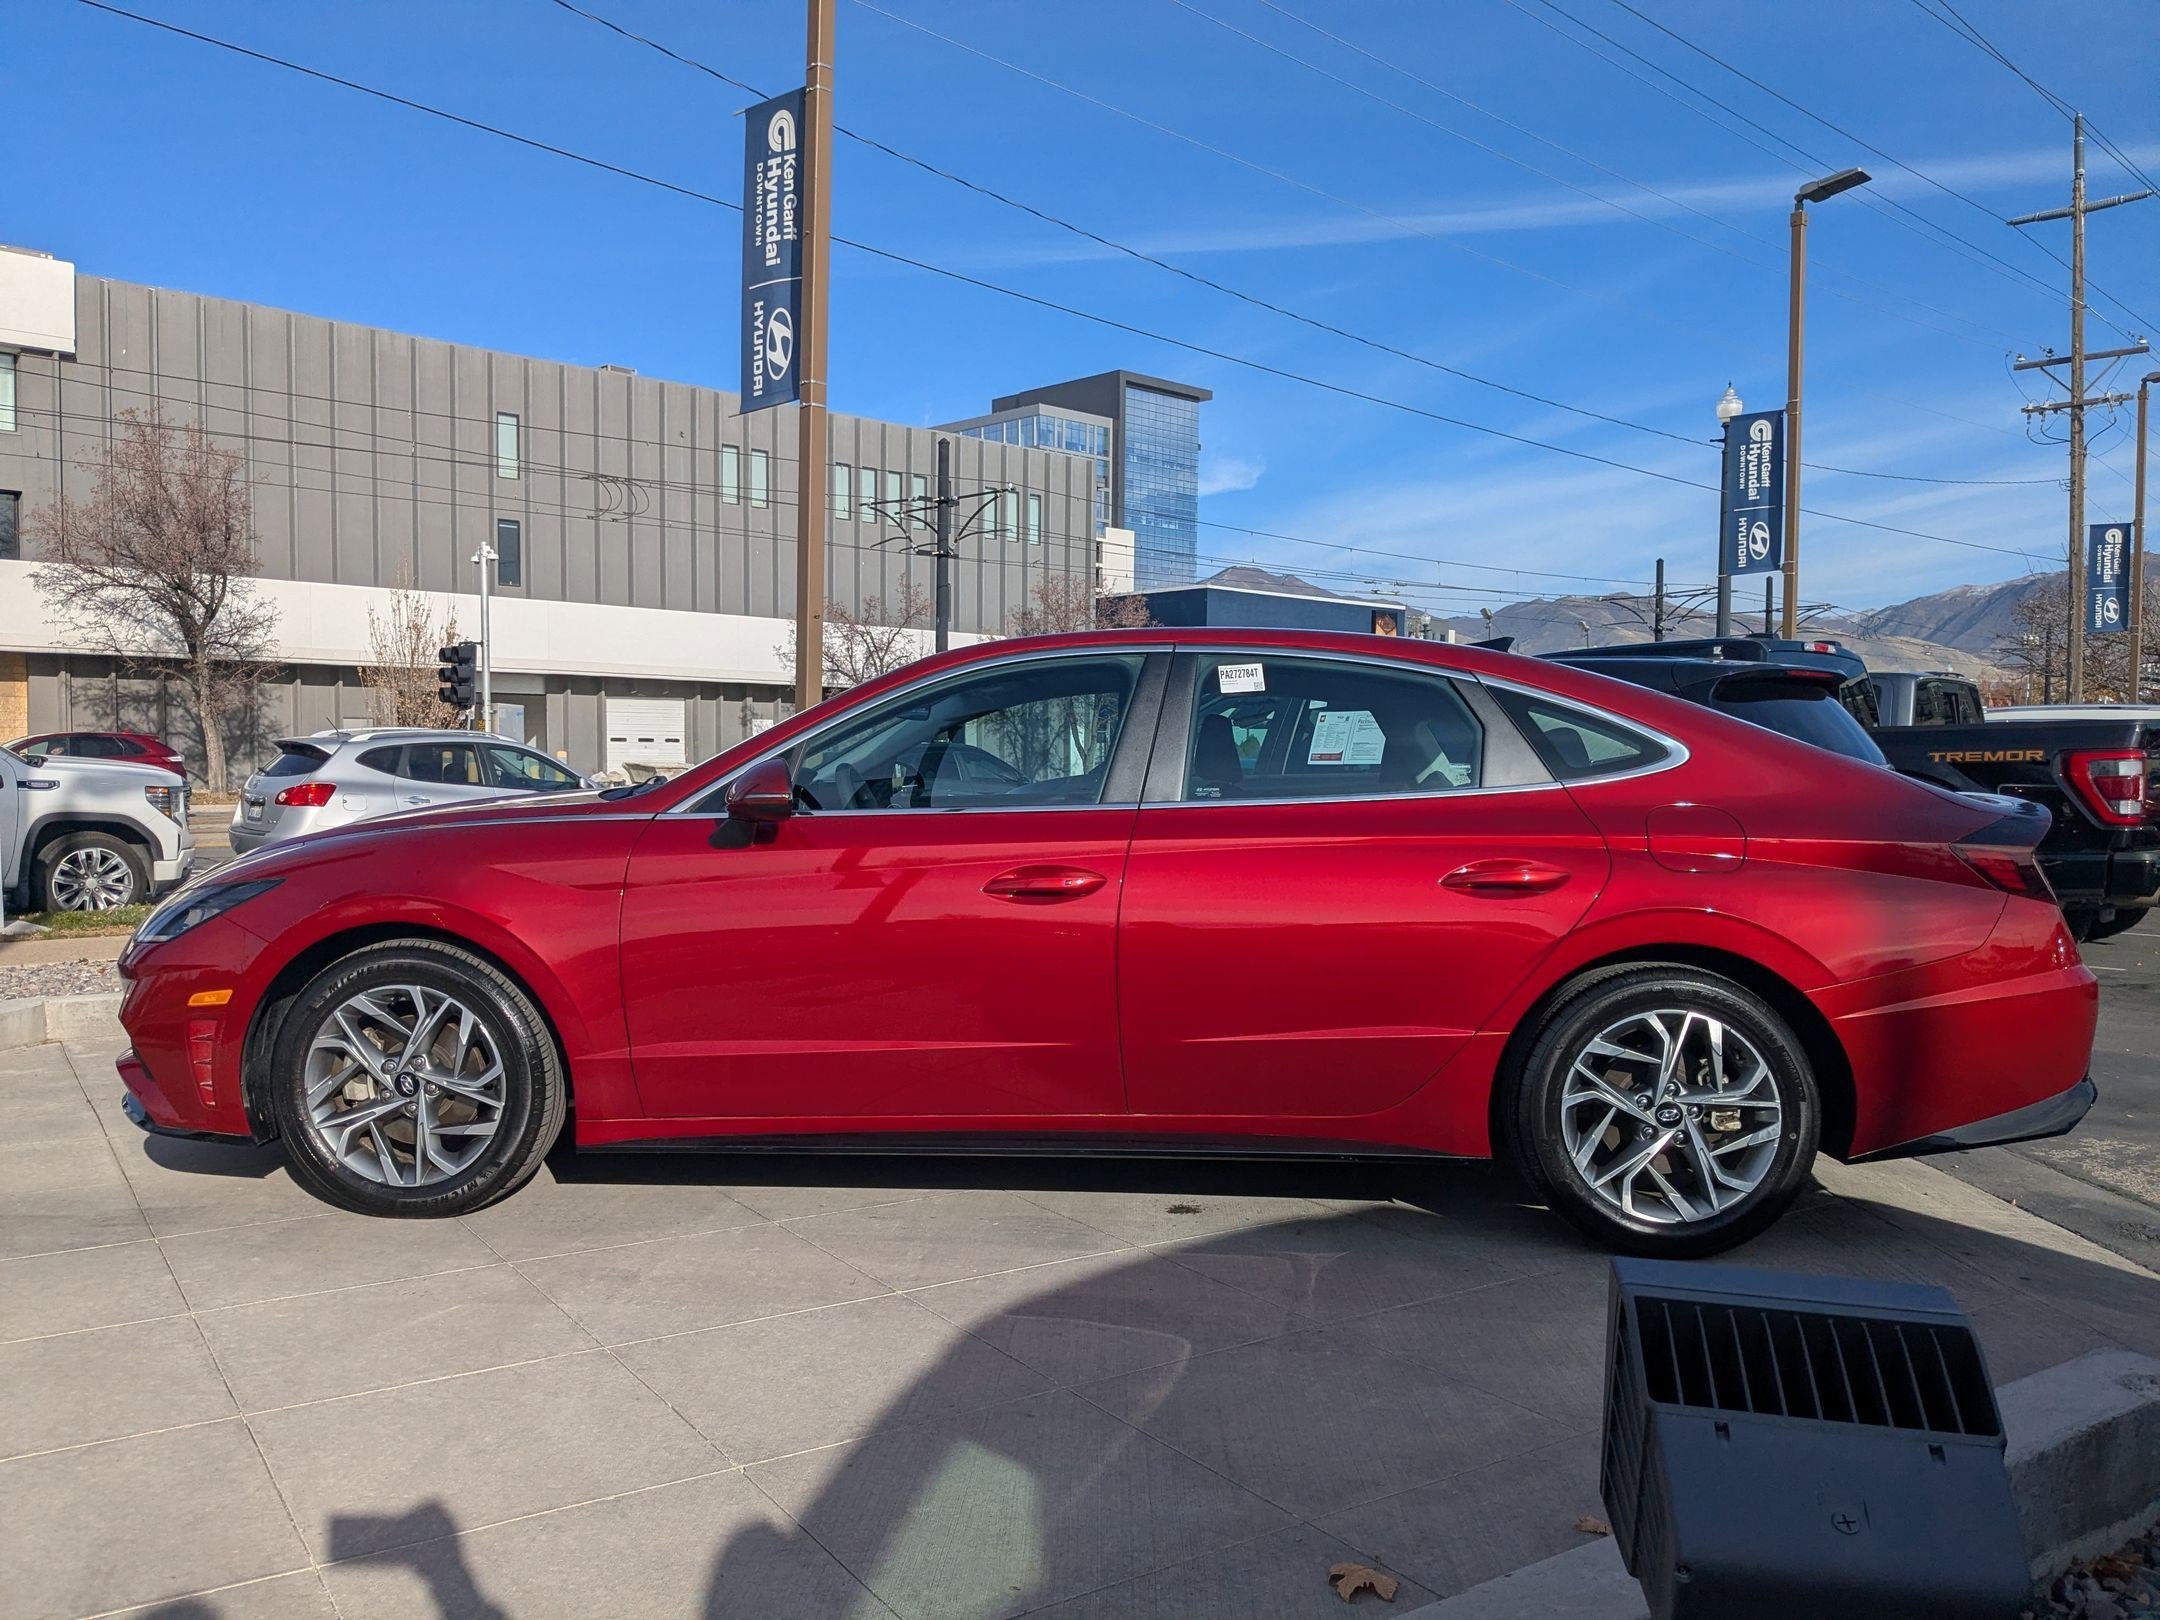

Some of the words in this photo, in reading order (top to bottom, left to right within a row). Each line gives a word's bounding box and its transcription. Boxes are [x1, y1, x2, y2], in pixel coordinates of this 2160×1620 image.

[784, 153, 797, 192] Ken
[755, 162, 763, 247] DOWNTOWN
[765, 156, 781, 267] Hyundai
[783, 193, 797, 240] Garff
[753, 300, 764, 397] HYUNDAI
[1747, 443, 1760, 500] Hyundai
[1762, 442, 1772, 462] Ken
[1738, 517, 1747, 568] HYUNDAI
[2103, 545, 2113, 582] Hyundai
[1220, 668, 1258, 680] PA272784T
[1929, 750, 2044, 762] TREMOR
